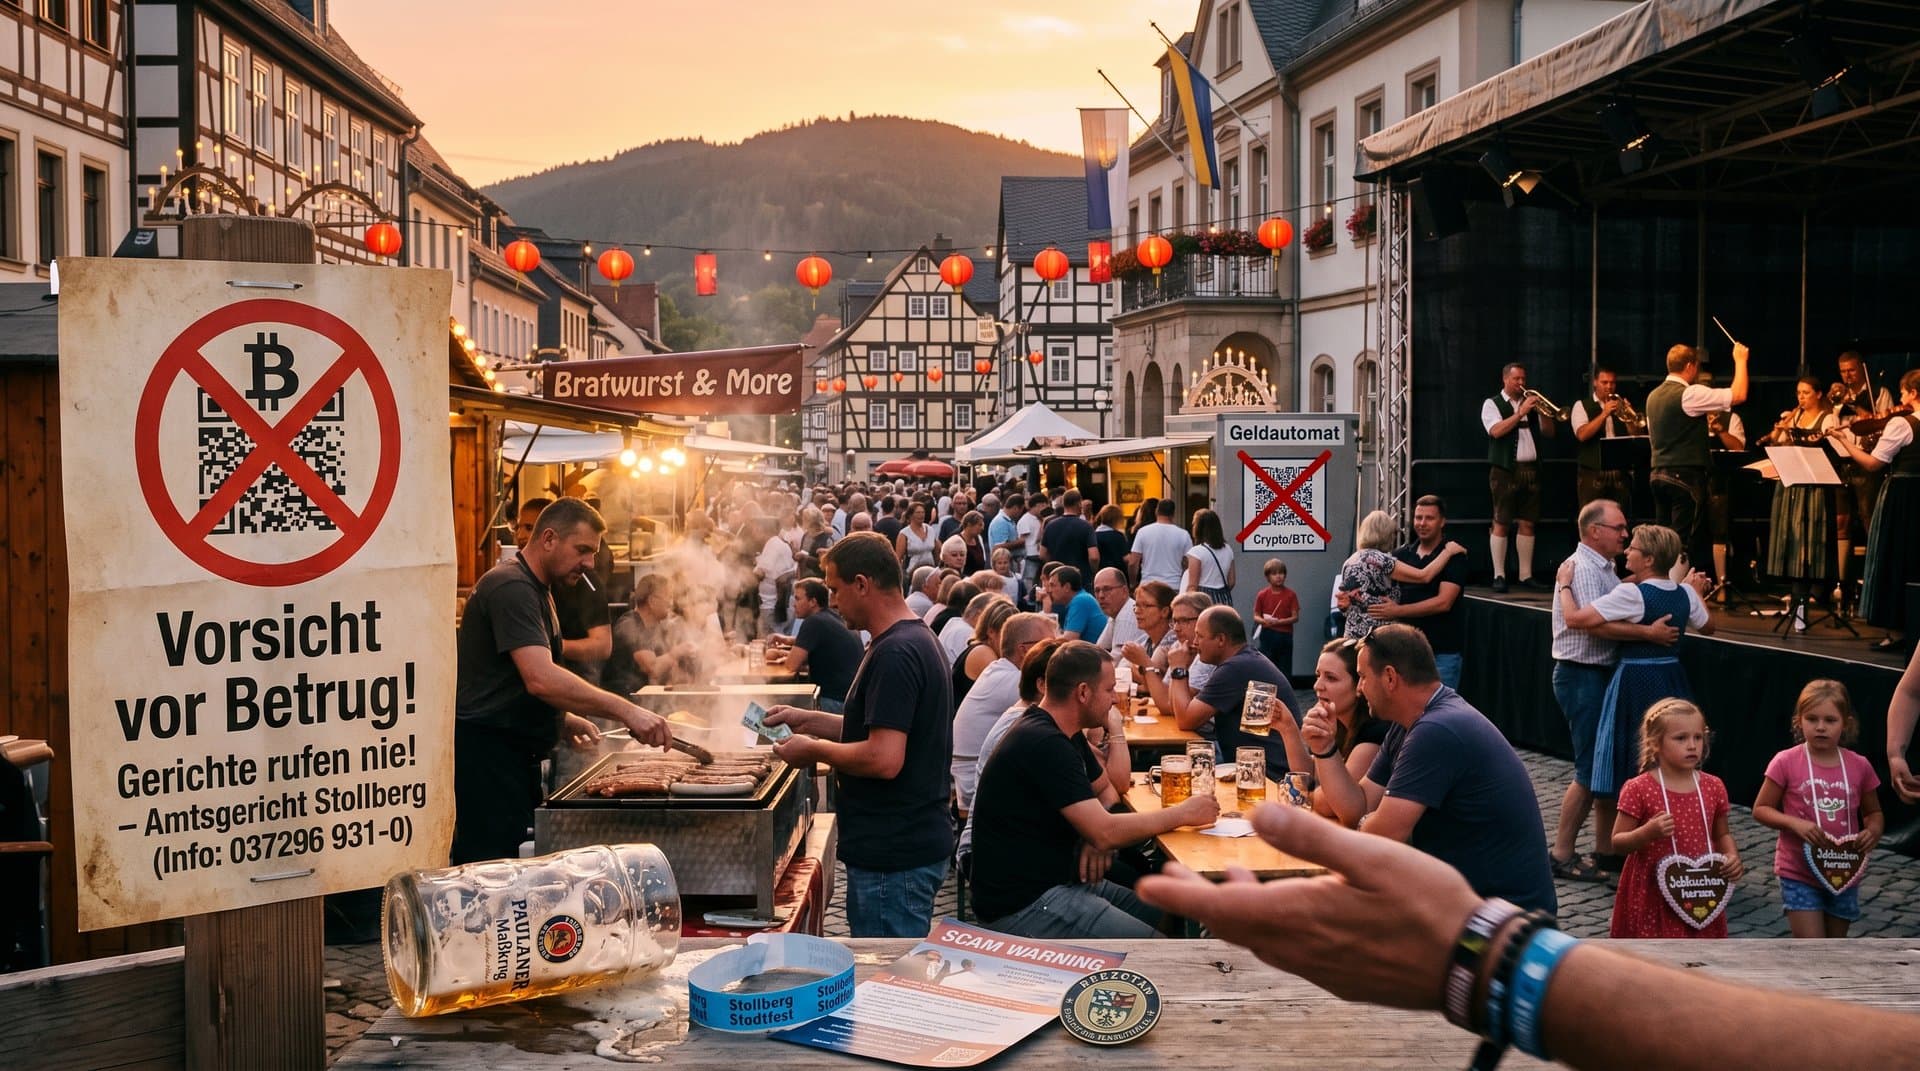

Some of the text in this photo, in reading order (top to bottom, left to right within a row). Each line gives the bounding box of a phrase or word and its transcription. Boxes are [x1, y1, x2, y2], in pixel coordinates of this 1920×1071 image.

[553, 367, 793, 398] Bratwurst & More
[1230, 424, 1340, 441] Geldautomat
[1253, 534, 1315, 547] Crypto/BTC
[156, 600, 382, 667] Vorsicht
[114, 661, 417, 742] vor Betrug!
[117, 734, 416, 800] Gerichte rufen nie!
[144, 791, 308, 834] Amtsgericht
[314, 781, 427, 815] Stollberg
[152, 815, 413, 881] (Info: 037296 931-0)
[511, 899, 530, 992] PAULANER
[941, 930, 1106, 971] SCAM WARNING
[729, 996, 794, 1012] Stollberg
